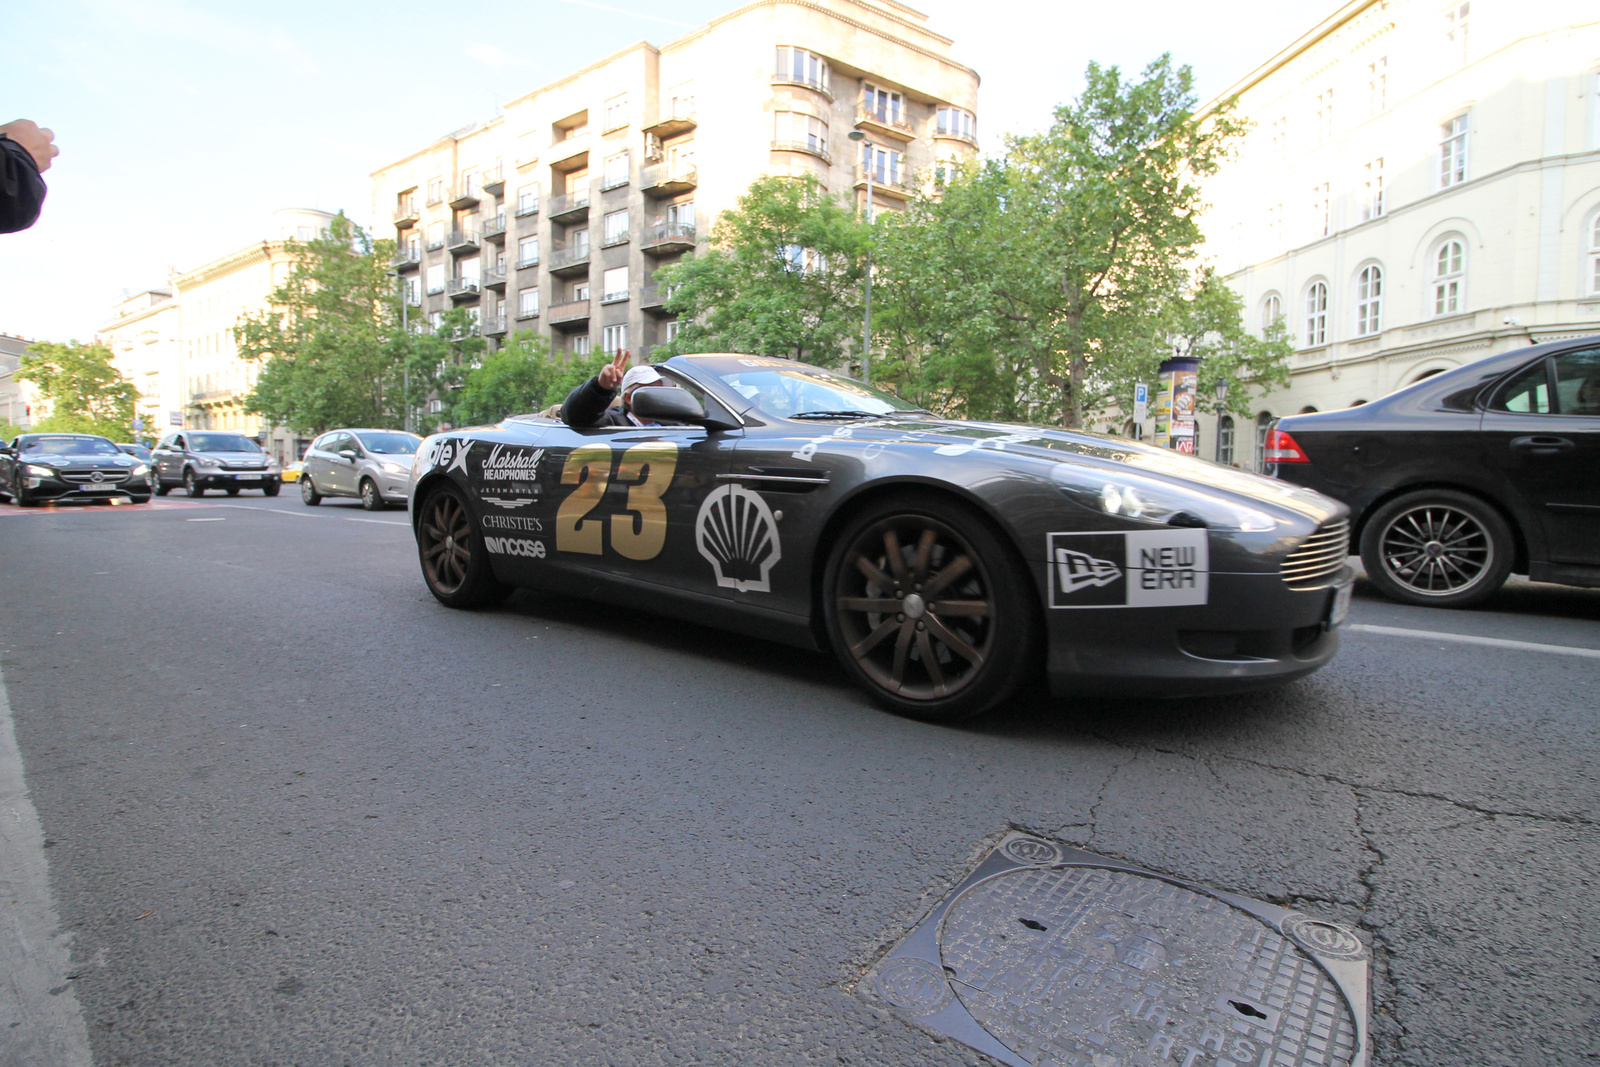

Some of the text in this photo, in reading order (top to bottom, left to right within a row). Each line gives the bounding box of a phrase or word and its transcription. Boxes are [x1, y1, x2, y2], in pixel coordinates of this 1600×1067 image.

[1137, 388, 1145, 401] P
[481, 443, 545, 469] Marshall
[484, 469, 536, 480] HEADPHONES
[556, 441, 678, 561] 23
[482, 514, 543, 531] CHRISTIE'S
[494, 536, 546, 559] incase
[1140, 546, 1196, 568] NEW
[1141, 569, 1196, 590] ERA
